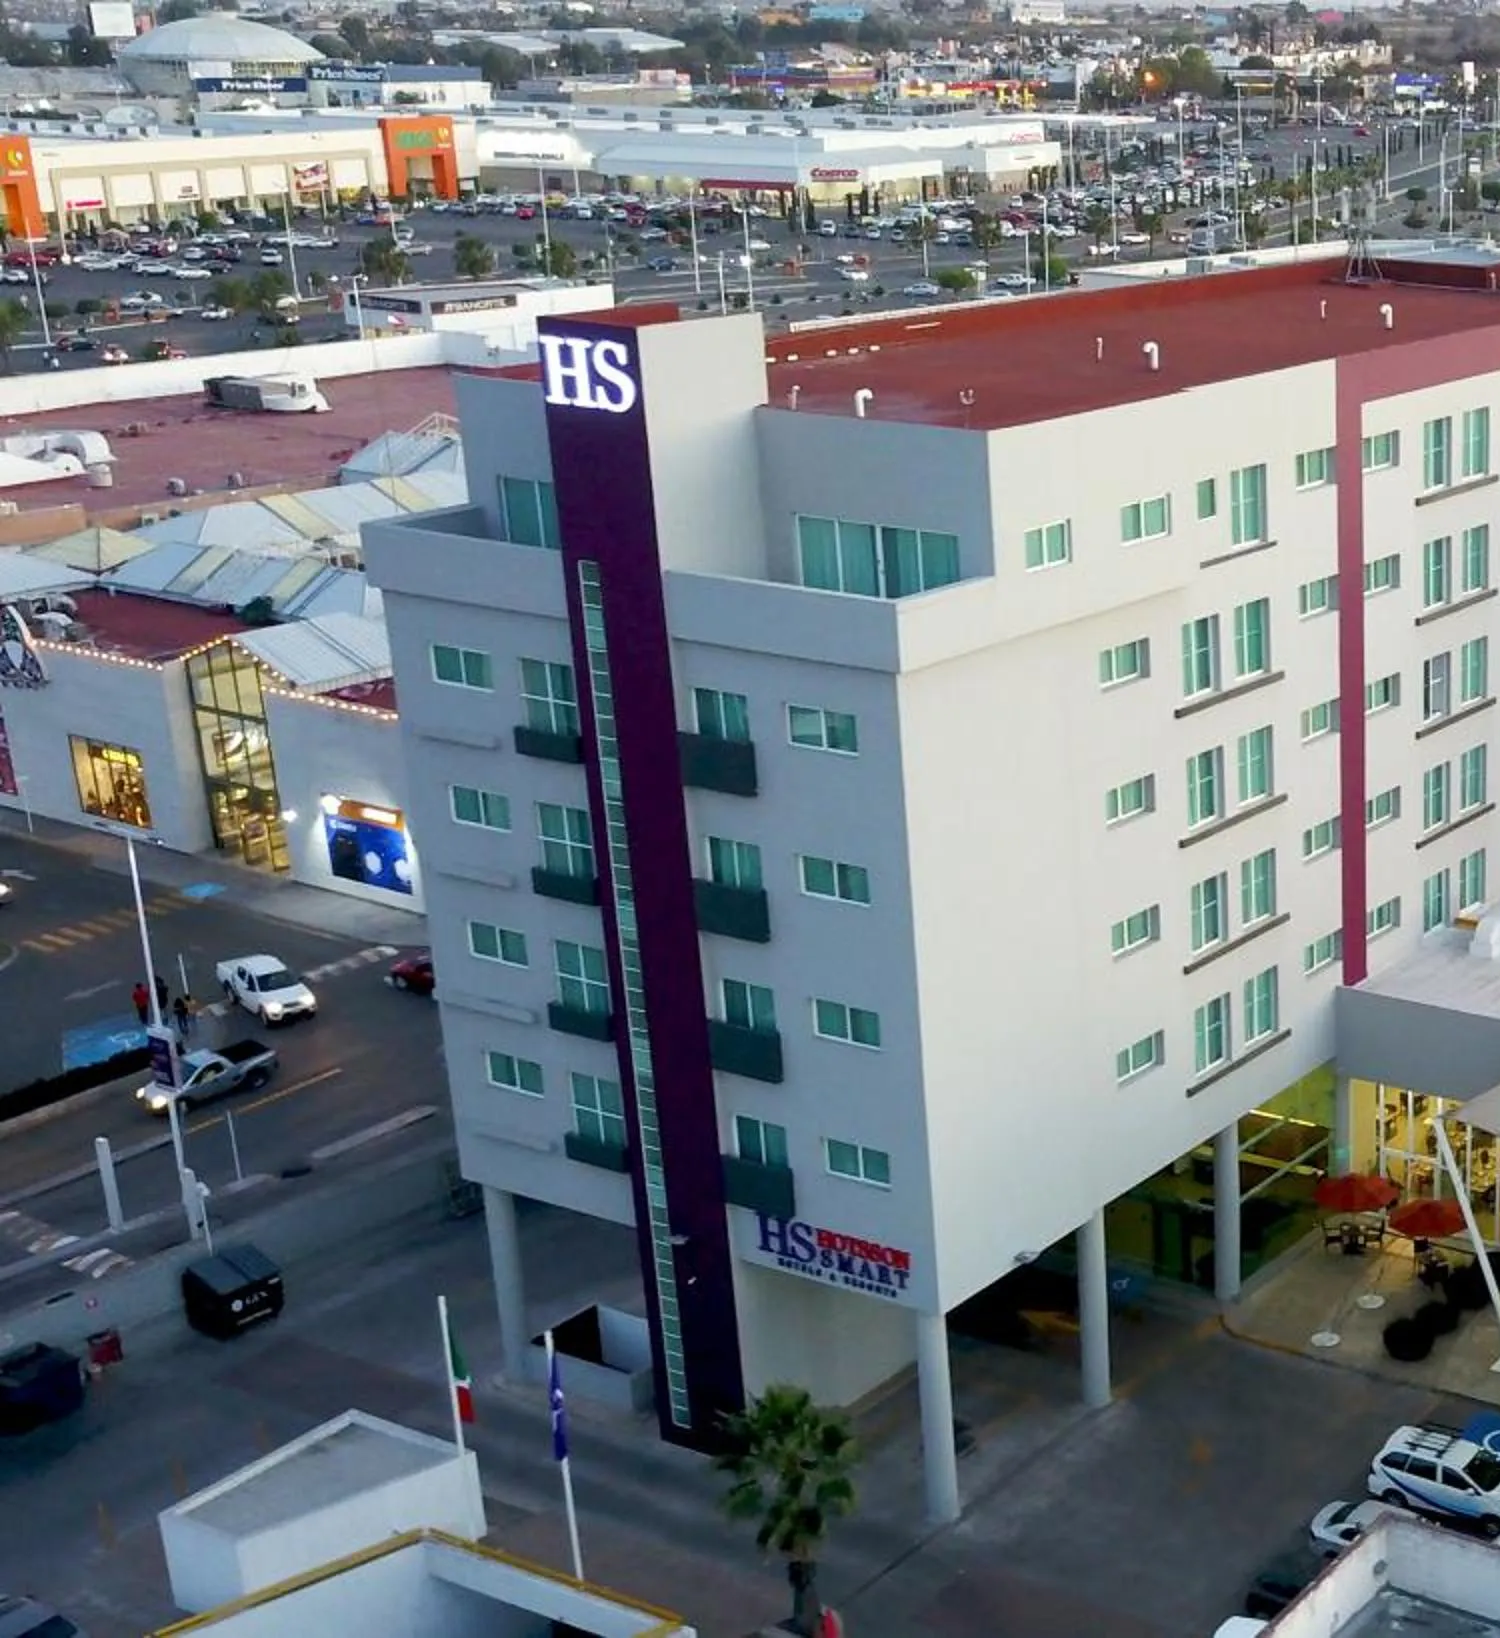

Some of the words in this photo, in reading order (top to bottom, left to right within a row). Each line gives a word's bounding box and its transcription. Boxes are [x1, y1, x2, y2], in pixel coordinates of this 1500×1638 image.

[539, 334, 636, 413] HS
[756, 1212, 817, 1262] HS
[821, 1249, 910, 1289] SMART
